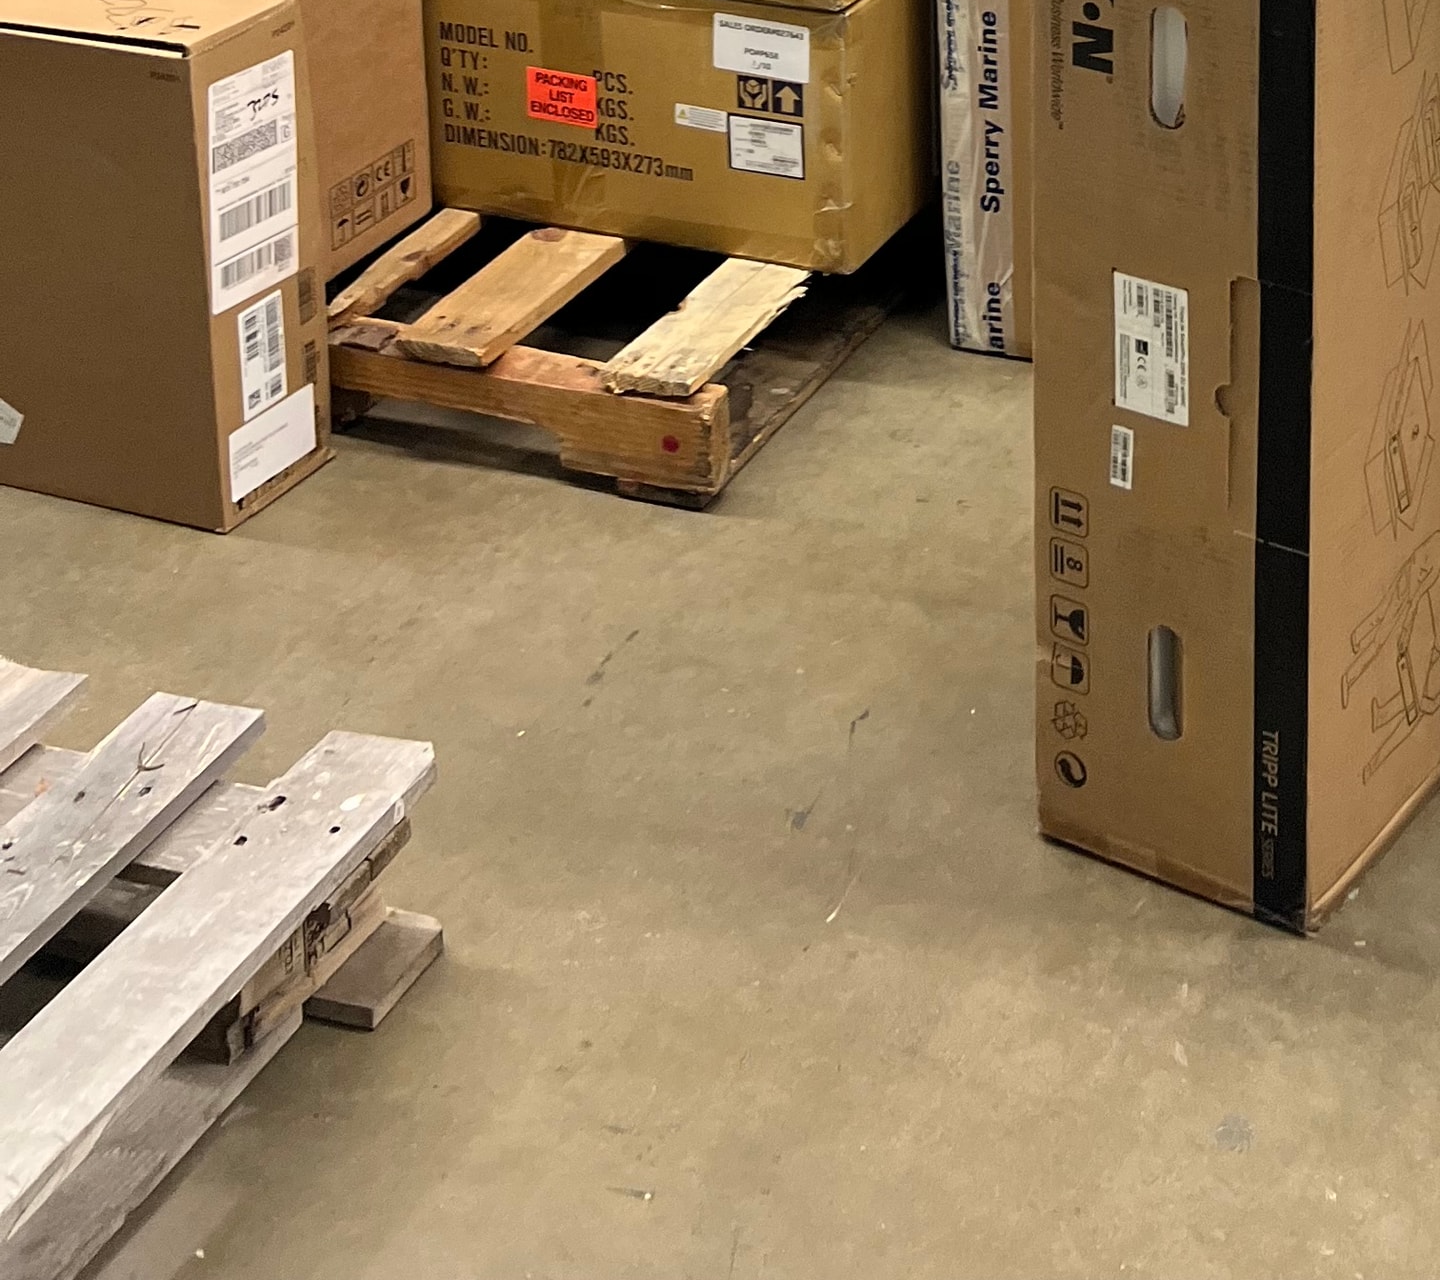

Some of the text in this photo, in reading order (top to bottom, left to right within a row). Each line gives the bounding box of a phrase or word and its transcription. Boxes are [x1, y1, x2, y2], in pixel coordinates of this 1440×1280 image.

[439, 21, 534, 53] MODEL NO.
[440, 46, 488, 70] Q'TY:
[535, 72, 588, 91] PACKING
[1047, 51, 1064, 121] Worldwide
[549, 89, 575, 103] LIST
[530, 101, 594, 123] ENCLOSED
[977, 10, 1005, 214] Sperry Marine
[594, 124, 636, 146] KGS.
[1262, 731, 1280, 787] TRIPP
[1261, 791, 1280, 836] LITE
